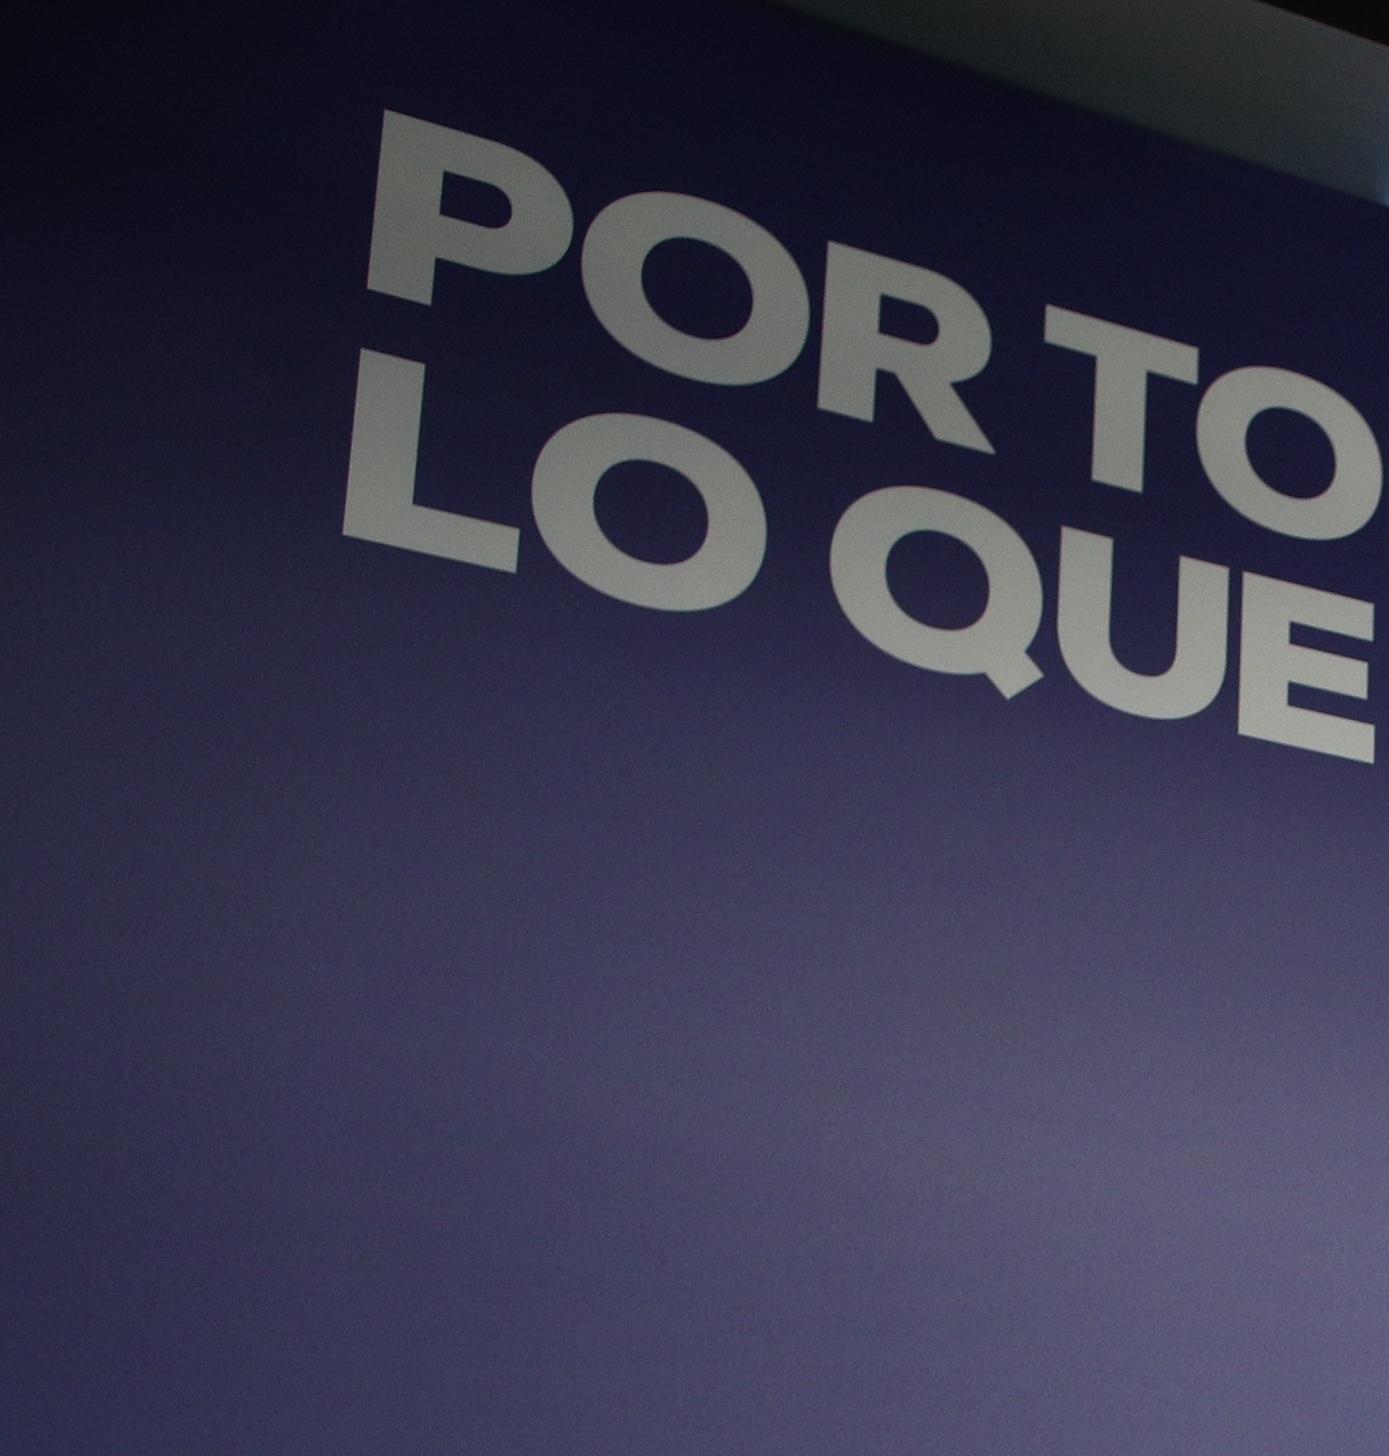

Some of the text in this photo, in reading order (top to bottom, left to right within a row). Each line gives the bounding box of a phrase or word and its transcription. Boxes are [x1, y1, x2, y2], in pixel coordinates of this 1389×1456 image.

[367, 109, 996, 455] POR
[342, 347, 768, 612] LO
[829, 485, 1376, 765] QUE
